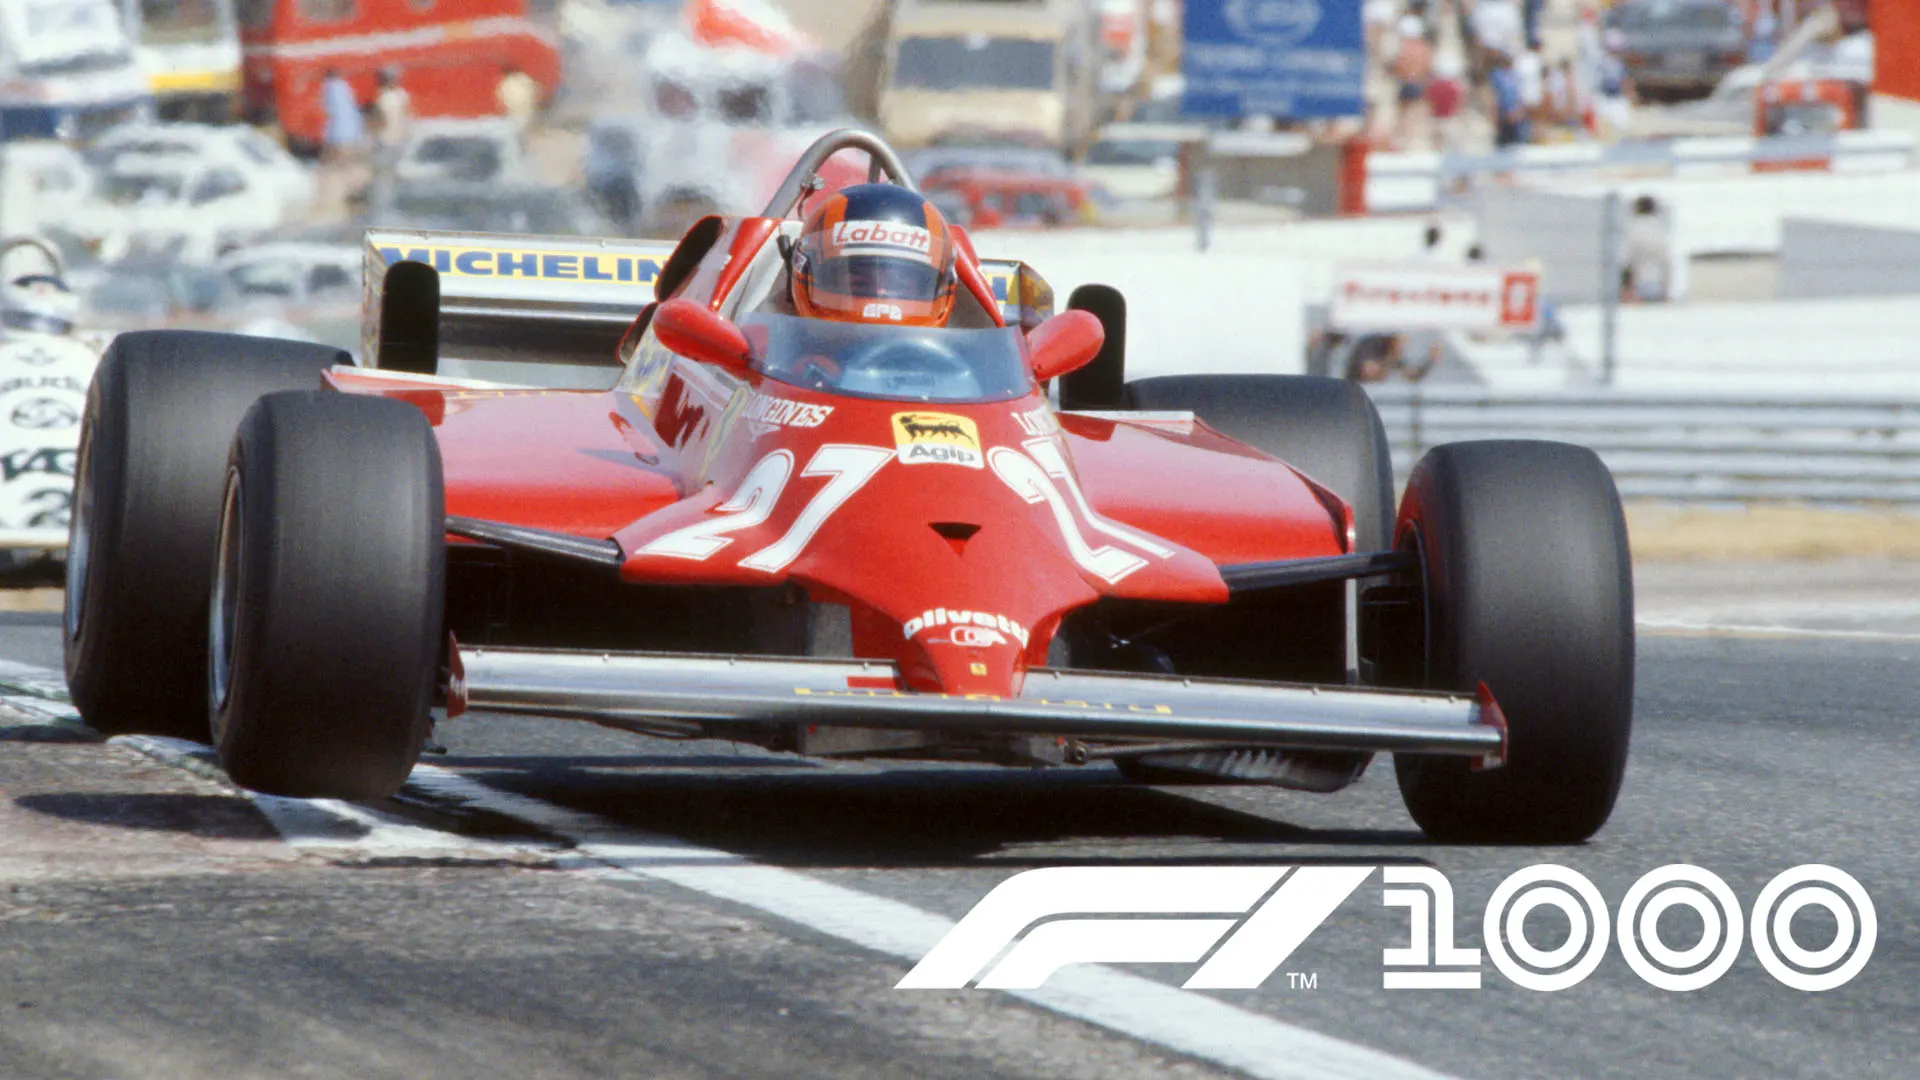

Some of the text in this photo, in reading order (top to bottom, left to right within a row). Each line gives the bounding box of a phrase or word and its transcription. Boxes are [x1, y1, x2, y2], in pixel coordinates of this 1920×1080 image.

[835, 222, 927, 248] Labatt
[908, 443, 976, 463] Agip
[635, 443, 898, 573] 27
[986, 436, 1176, 585] 27
[903, 607, 1030, 650] olivetti
